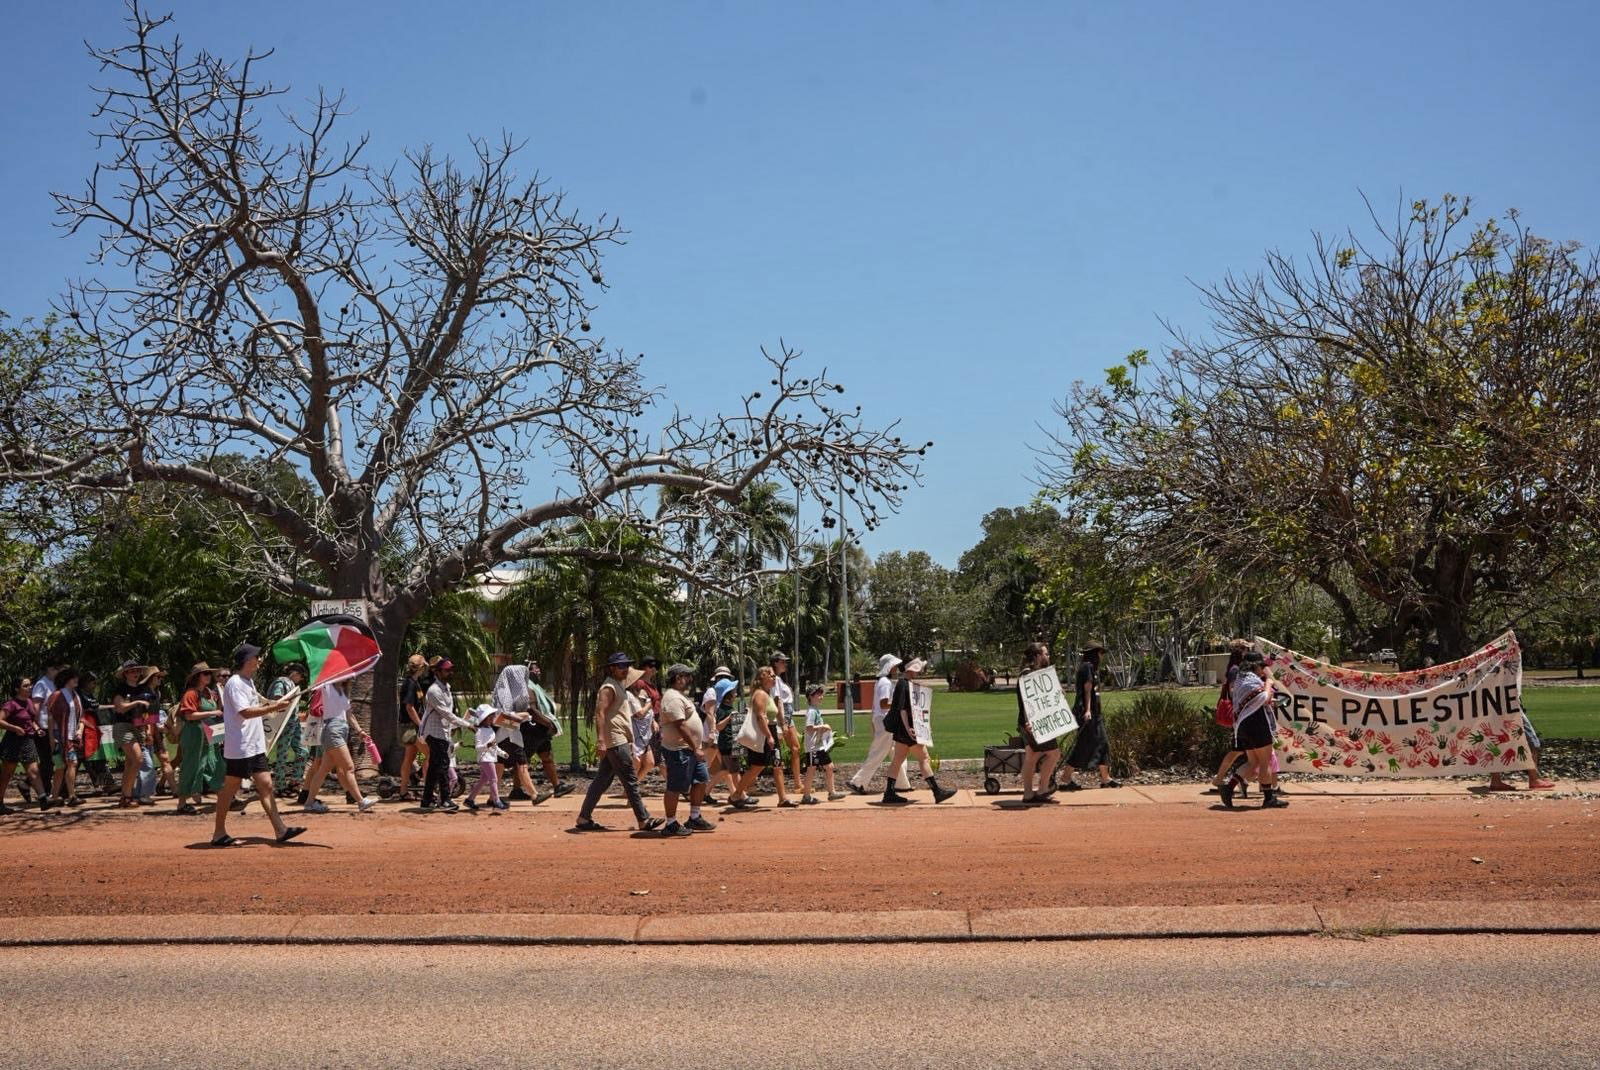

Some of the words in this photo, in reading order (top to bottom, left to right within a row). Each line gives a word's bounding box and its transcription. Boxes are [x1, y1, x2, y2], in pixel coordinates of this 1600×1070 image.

[1023, 673, 1053, 698] END
[1034, 694, 1052, 711] THE
[1273, 692, 1328, 723] REE
[1342, 684, 1520, 726] PALESTINE
